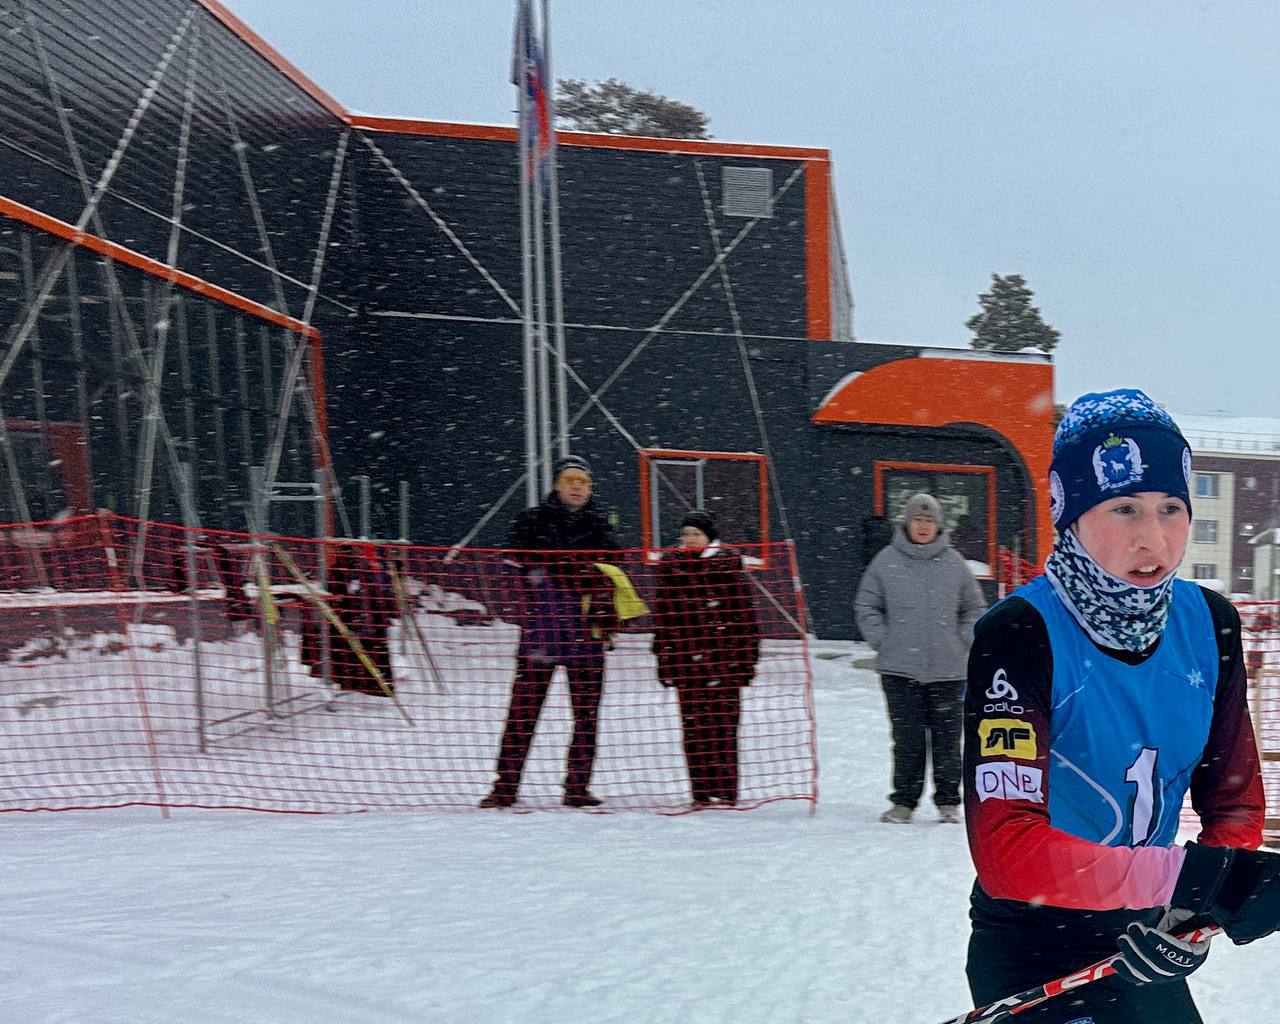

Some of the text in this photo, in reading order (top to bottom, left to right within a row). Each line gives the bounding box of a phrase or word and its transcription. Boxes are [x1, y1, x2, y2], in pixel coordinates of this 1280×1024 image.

[983, 702, 1024, 715] odlo
[1124, 746, 1158, 848] 1
[1155, 943, 1193, 965] MOAX
